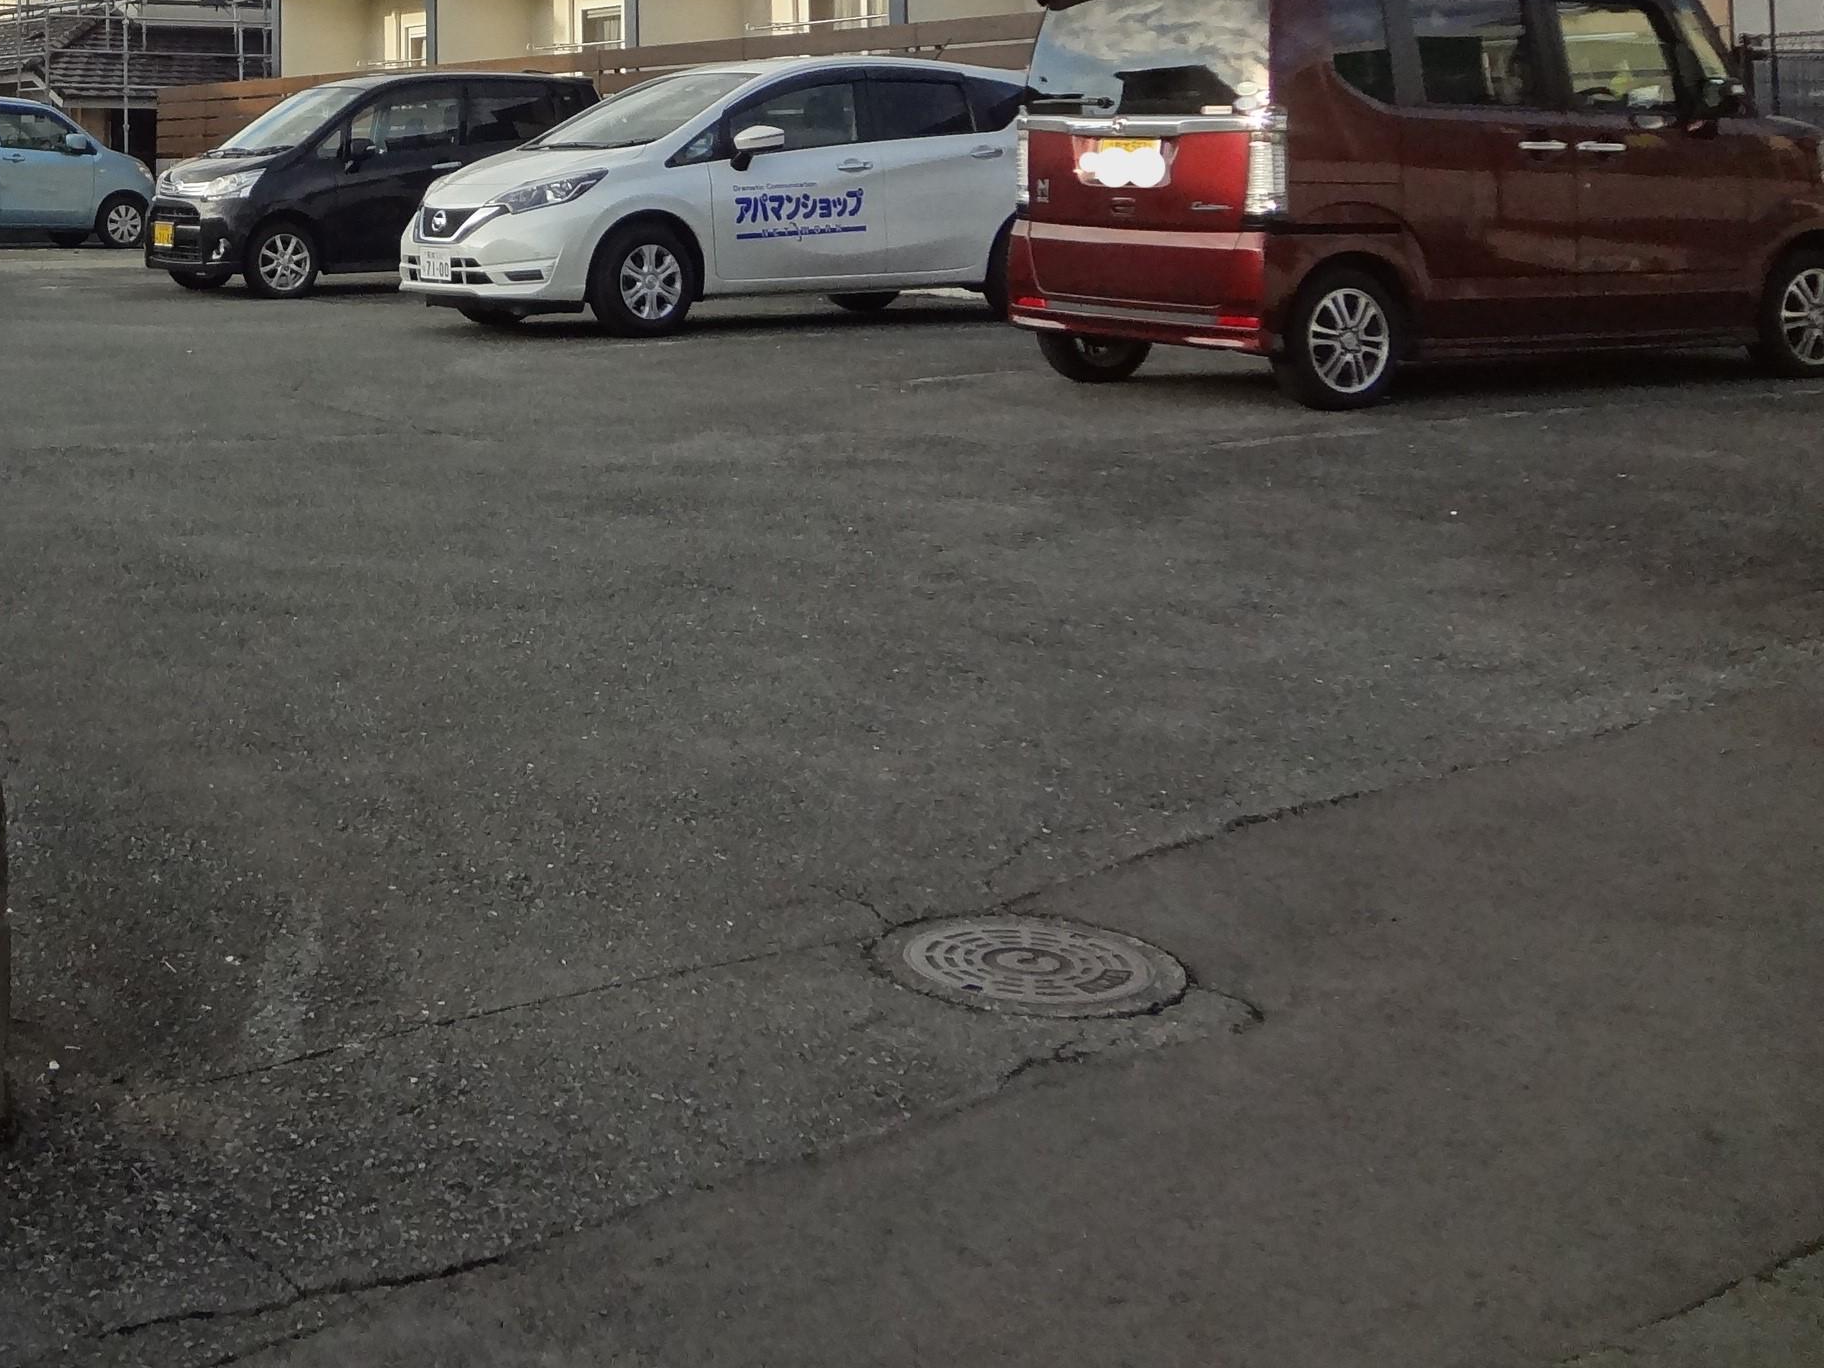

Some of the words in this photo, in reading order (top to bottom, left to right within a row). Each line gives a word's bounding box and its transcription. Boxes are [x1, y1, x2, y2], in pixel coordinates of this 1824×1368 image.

[735, 188, 864, 224] アパマンショップ
